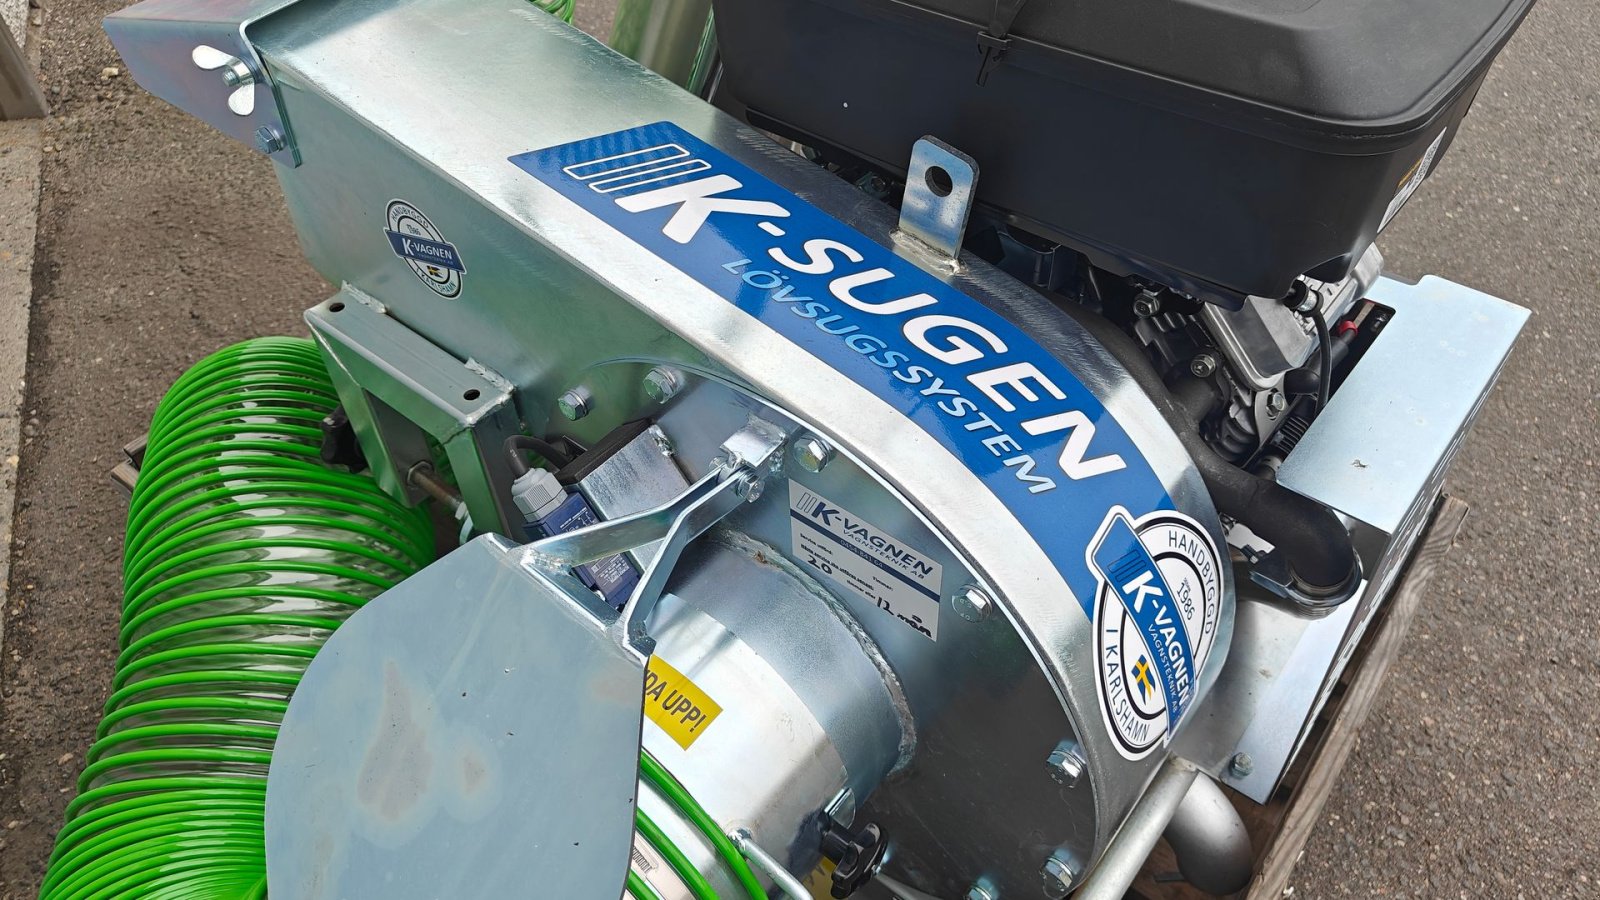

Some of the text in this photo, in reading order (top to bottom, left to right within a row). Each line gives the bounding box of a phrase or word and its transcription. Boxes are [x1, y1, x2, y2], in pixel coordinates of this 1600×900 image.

[402, 238, 452, 259] K-VAGNEN
[614, 170, 1127, 481] K-SUGEN
[721, 258, 1057, 494] LÖVSUGSSYSTEM
[808, 554, 832, 575] 20
[811, 501, 933, 575] K-VAGNEN
[844, 530, 924, 579] VAGNSTEKNIK AB
[1168, 530, 1215, 634] HANDBYGGD
[1177, 582, 1195, 620] 1986
[1122, 570, 1190, 706] K-VAGNEN
[1148, 624, 1177, 698] VAGNSTEKNIK
[662, 689, 707, 733] UPP!
[1105, 645, 1150, 742] KARLSHAMN
